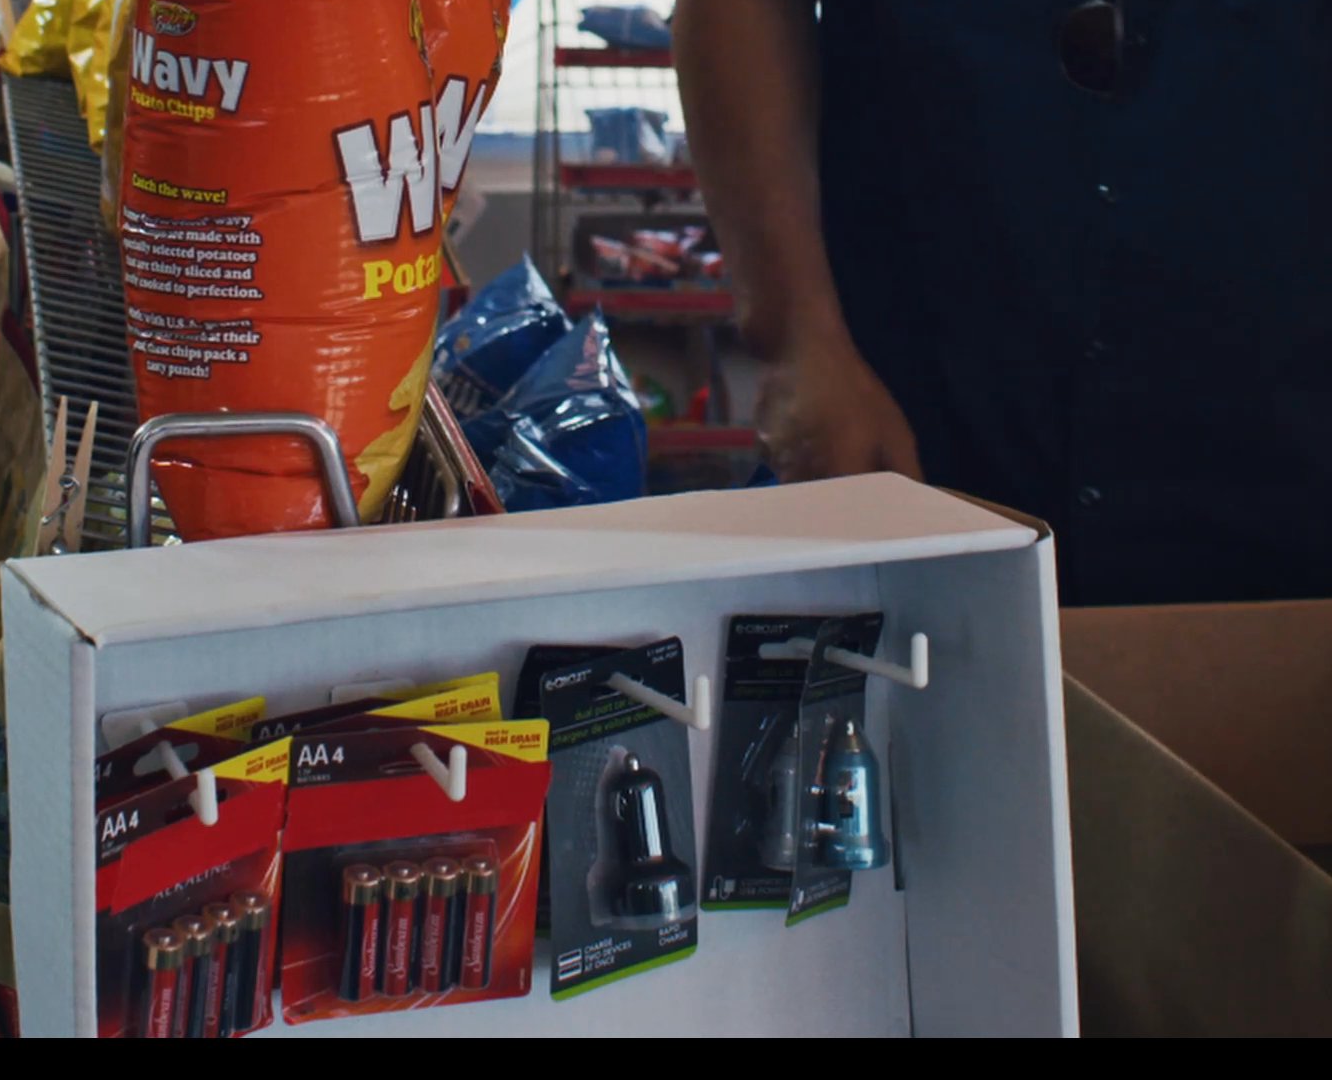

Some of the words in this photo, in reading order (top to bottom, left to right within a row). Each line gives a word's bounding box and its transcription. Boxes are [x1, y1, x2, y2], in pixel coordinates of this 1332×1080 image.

[132, 29, 248, 113] Wavy
[131, 87, 165, 111] Potato
[168, 99, 215, 123] Chips
[158, 182, 180, 199] the
[181, 187, 227, 204] wave!
[186, 229, 223, 243] made
[224, 231, 261, 245] with
[152, 244, 195, 260] selected
[196, 249, 257, 263] potatoes
[150, 259, 183, 278] thinly
[184, 262, 221, 280] sliced
[223, 267, 252, 281] and
[362, 253, 441, 300] Pota
[139, 278, 173, 292] cooked
[173, 282, 186, 294] to
[186, 284, 263, 300] perfection.
[222, 331, 260, 345] their
[171, 345, 202, 362] chips
[203, 347, 238, 363] pack
[238, 351, 249, 362] a
[167, 364, 210, 379] punch!
[510, 733, 541, 744] DRAIN
[296, 743, 329, 768] AA
[331, 746, 345, 764] 4
[101, 811, 127, 842] AA
[128, 809, 140, 829] 4
[363, 918, 379, 981] Sunbeam
[388, 917, 409, 981] Sunbeam
[422, 913, 441, 977] Sunbeam
[466, 911, 485, 974] Sunbeam
